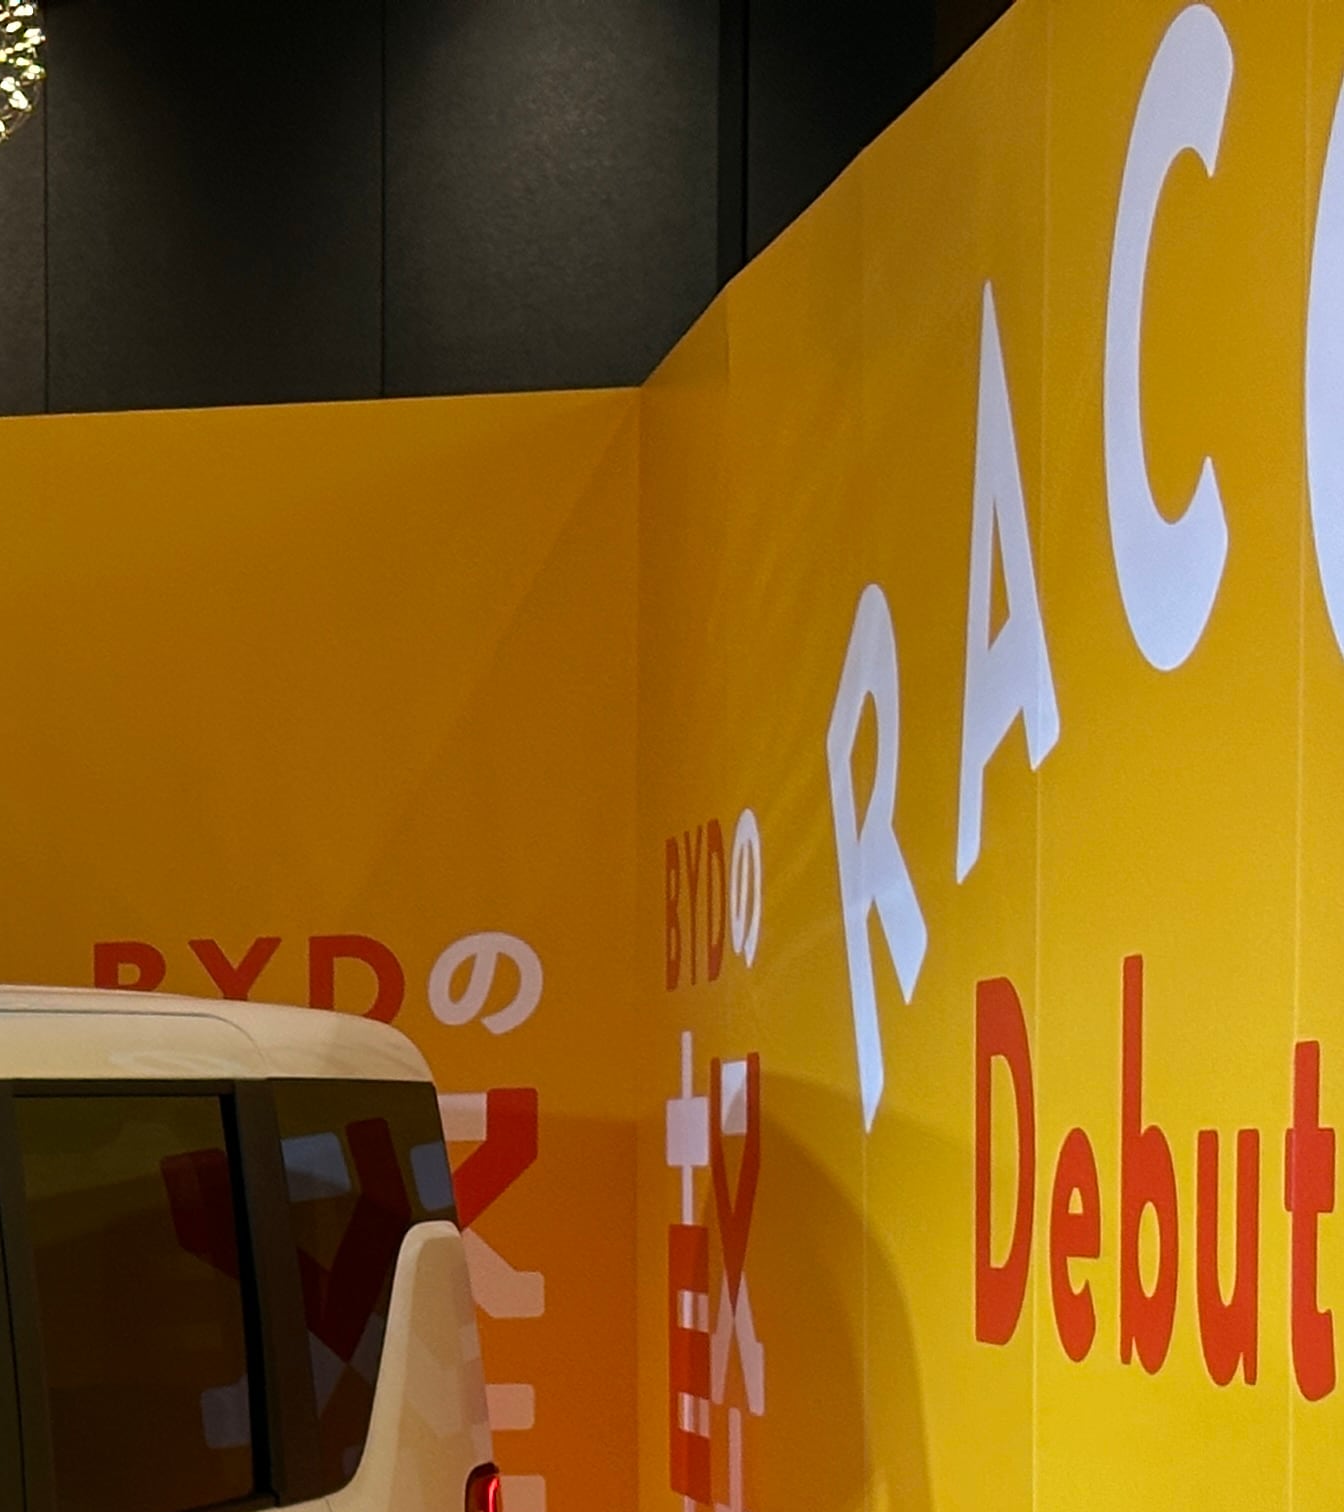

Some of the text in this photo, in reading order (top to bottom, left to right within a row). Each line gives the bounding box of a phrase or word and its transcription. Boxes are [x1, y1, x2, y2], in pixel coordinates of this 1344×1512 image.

[826, 2, 1344, 1132] RAC
[666, 808, 762, 991] BYDの
[975, 953, 1336, 1402] Debut
